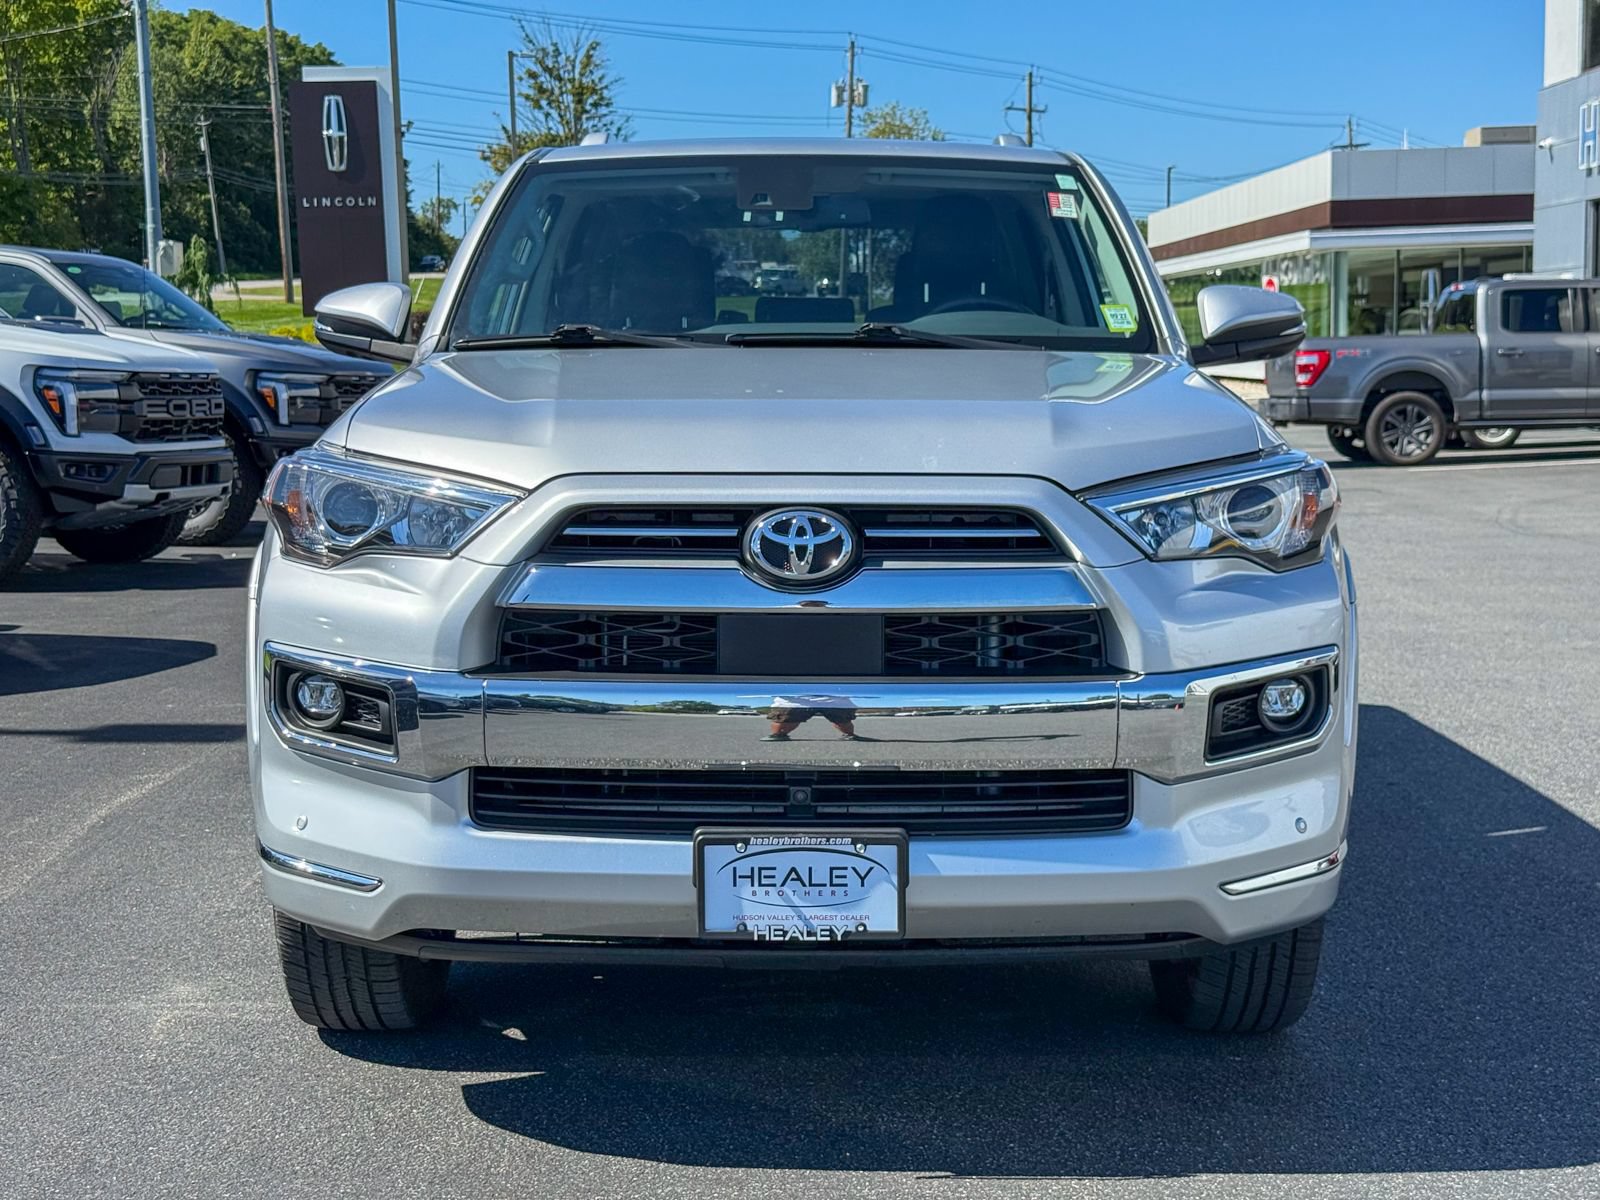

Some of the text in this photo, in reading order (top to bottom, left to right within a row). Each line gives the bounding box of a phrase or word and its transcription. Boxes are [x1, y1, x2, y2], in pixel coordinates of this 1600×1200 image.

[302, 196, 377, 208] LINCOLN
[142, 399, 225, 418] FORD
[749, 836, 852, 846] healeybrothers.com
[732, 866, 875, 888] HEALEY
[753, 924, 848, 941] HEALEY
